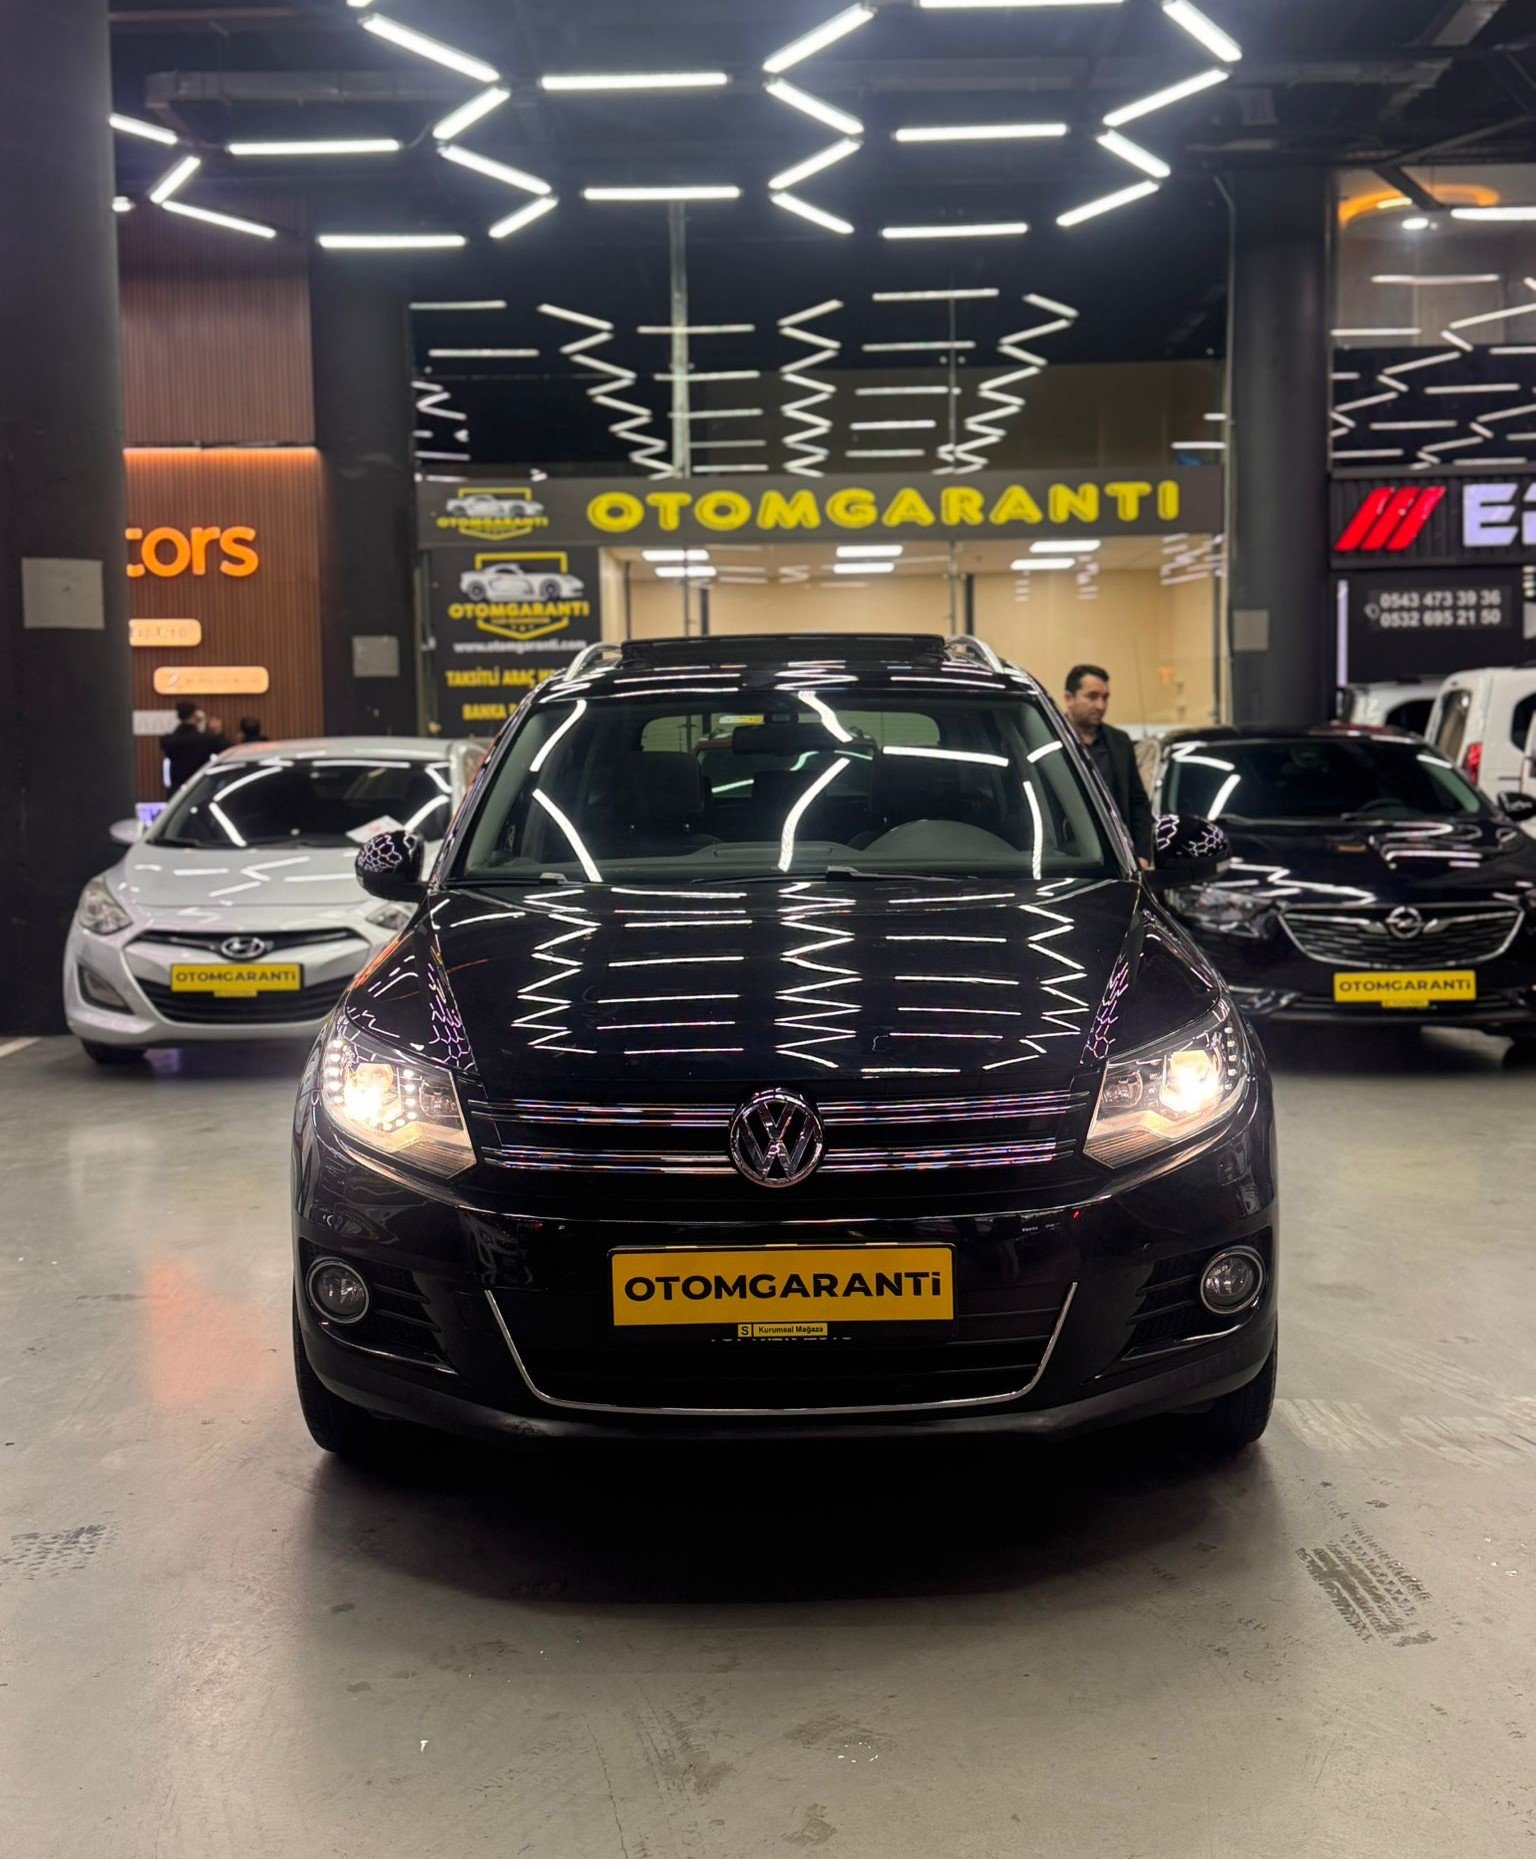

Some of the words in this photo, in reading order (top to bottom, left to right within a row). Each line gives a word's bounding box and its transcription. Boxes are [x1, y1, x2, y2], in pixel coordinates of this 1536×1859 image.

[586, 480, 1182, 533] OTOMGARANTI
[1463, 482, 1536, 547] E
[1380, 592, 1420, 609] 0543
[1423, 591, 1454, 607] 473
[1480, 589, 1501, 606] 36
[448, 601, 590, 619] OTOMGARANTI
[1380, 610, 1420, 628] 0532
[1456, 608, 1477, 625] 21
[758, 1324, 794, 1334] Kurumsal
[795, 1324, 824, 1335] Mağaza
